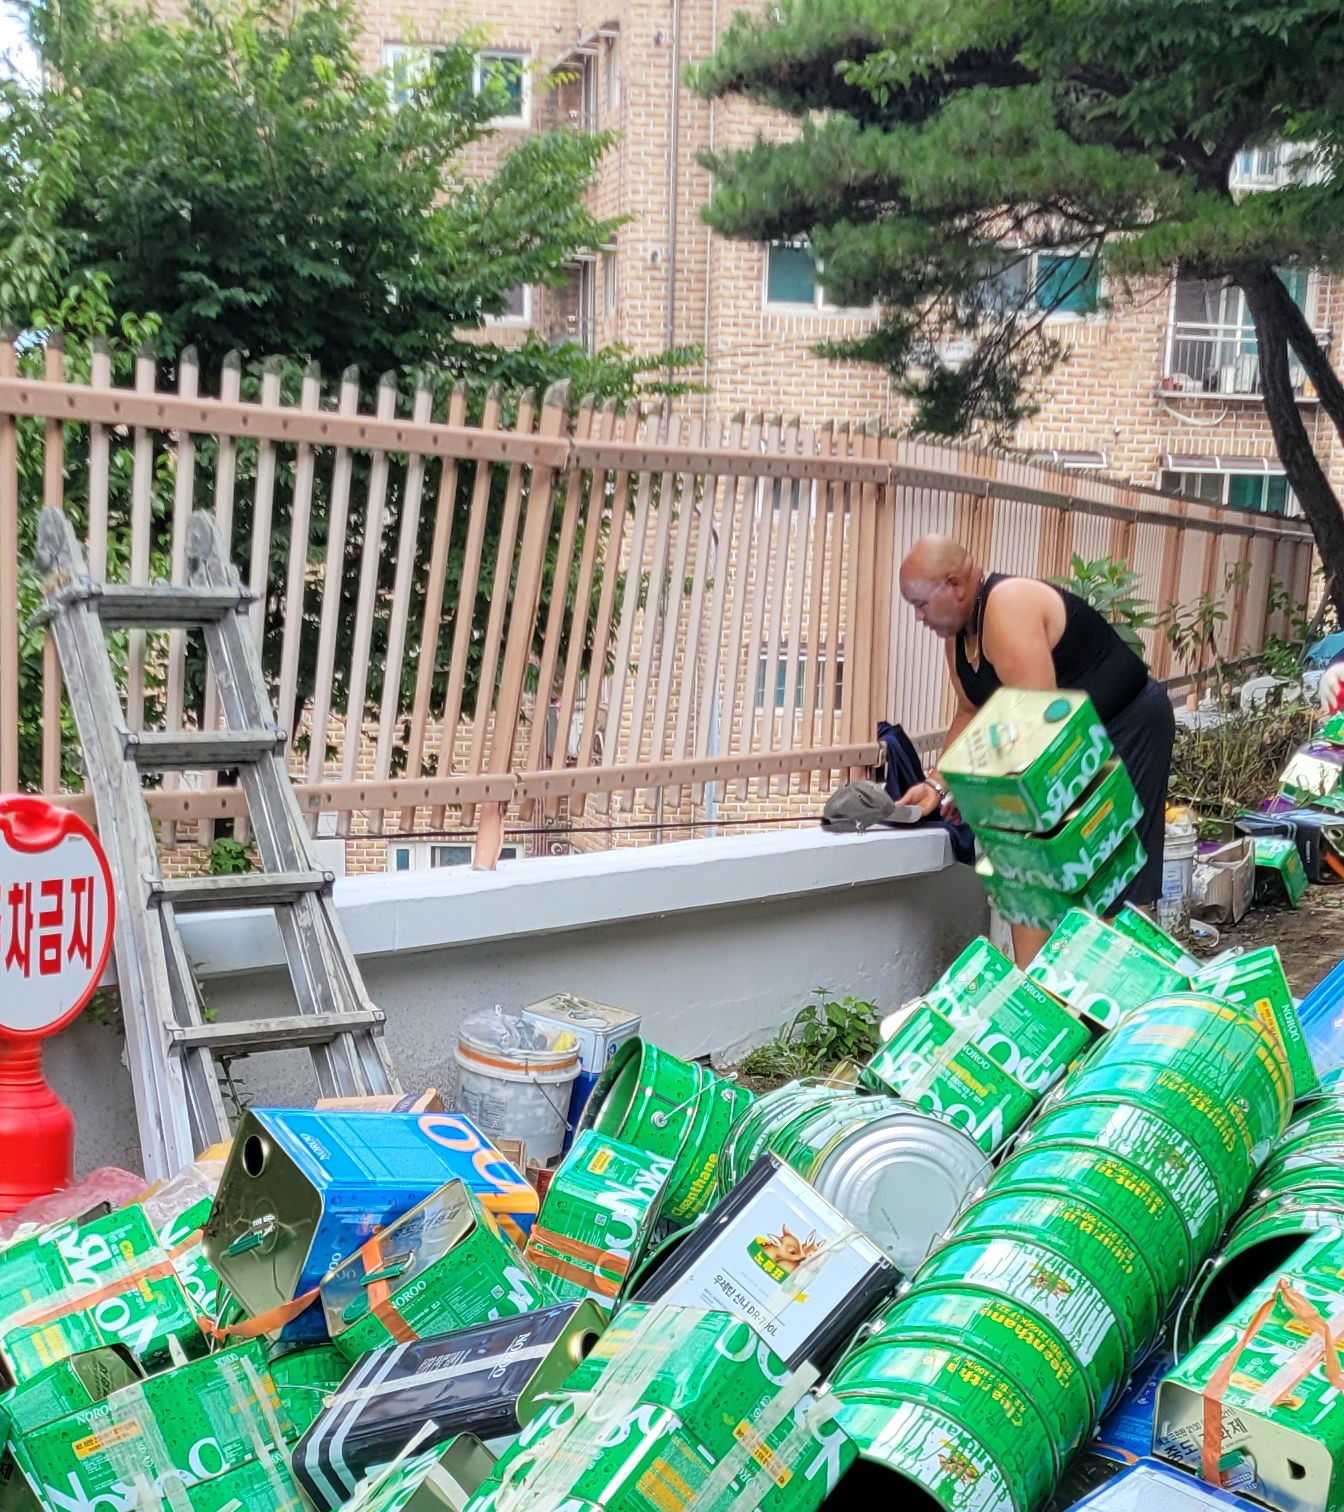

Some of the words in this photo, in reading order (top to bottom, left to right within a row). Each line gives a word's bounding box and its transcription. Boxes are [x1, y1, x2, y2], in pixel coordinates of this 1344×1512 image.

[669, 1152, 719, 1222] Cleanthane
[754, 1250, 786, 1284] 노루표
[712, 1272, 739, 1299] 우레탄
[731, 1292, 751, 1312] 신나
[491, 1329, 532, 1382] NOOO
